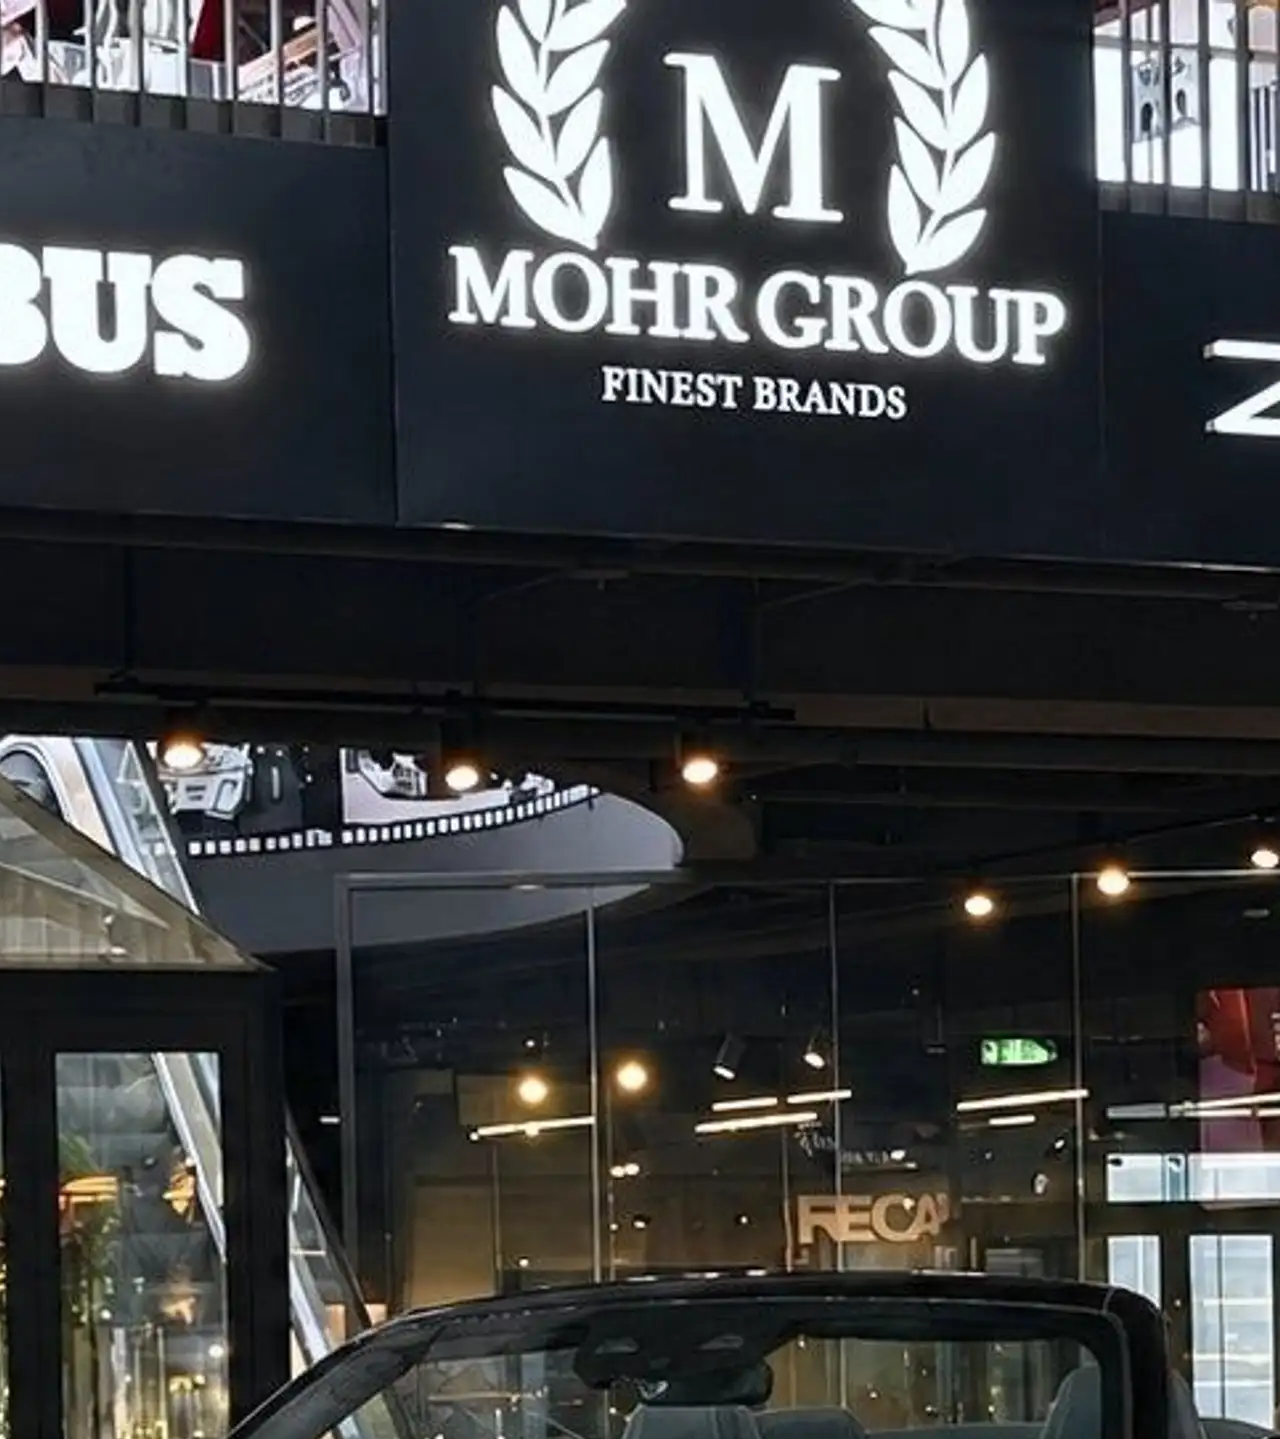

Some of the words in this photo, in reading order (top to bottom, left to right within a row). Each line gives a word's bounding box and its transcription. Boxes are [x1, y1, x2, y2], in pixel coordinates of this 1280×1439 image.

[663, 52, 844, 223] M
[448, 245, 749, 344] MOHR
[755, 270, 1067, 366] GROUP
[601, 366, 743, 411] FINEST
[753, 376, 907, 420] BRANDS
